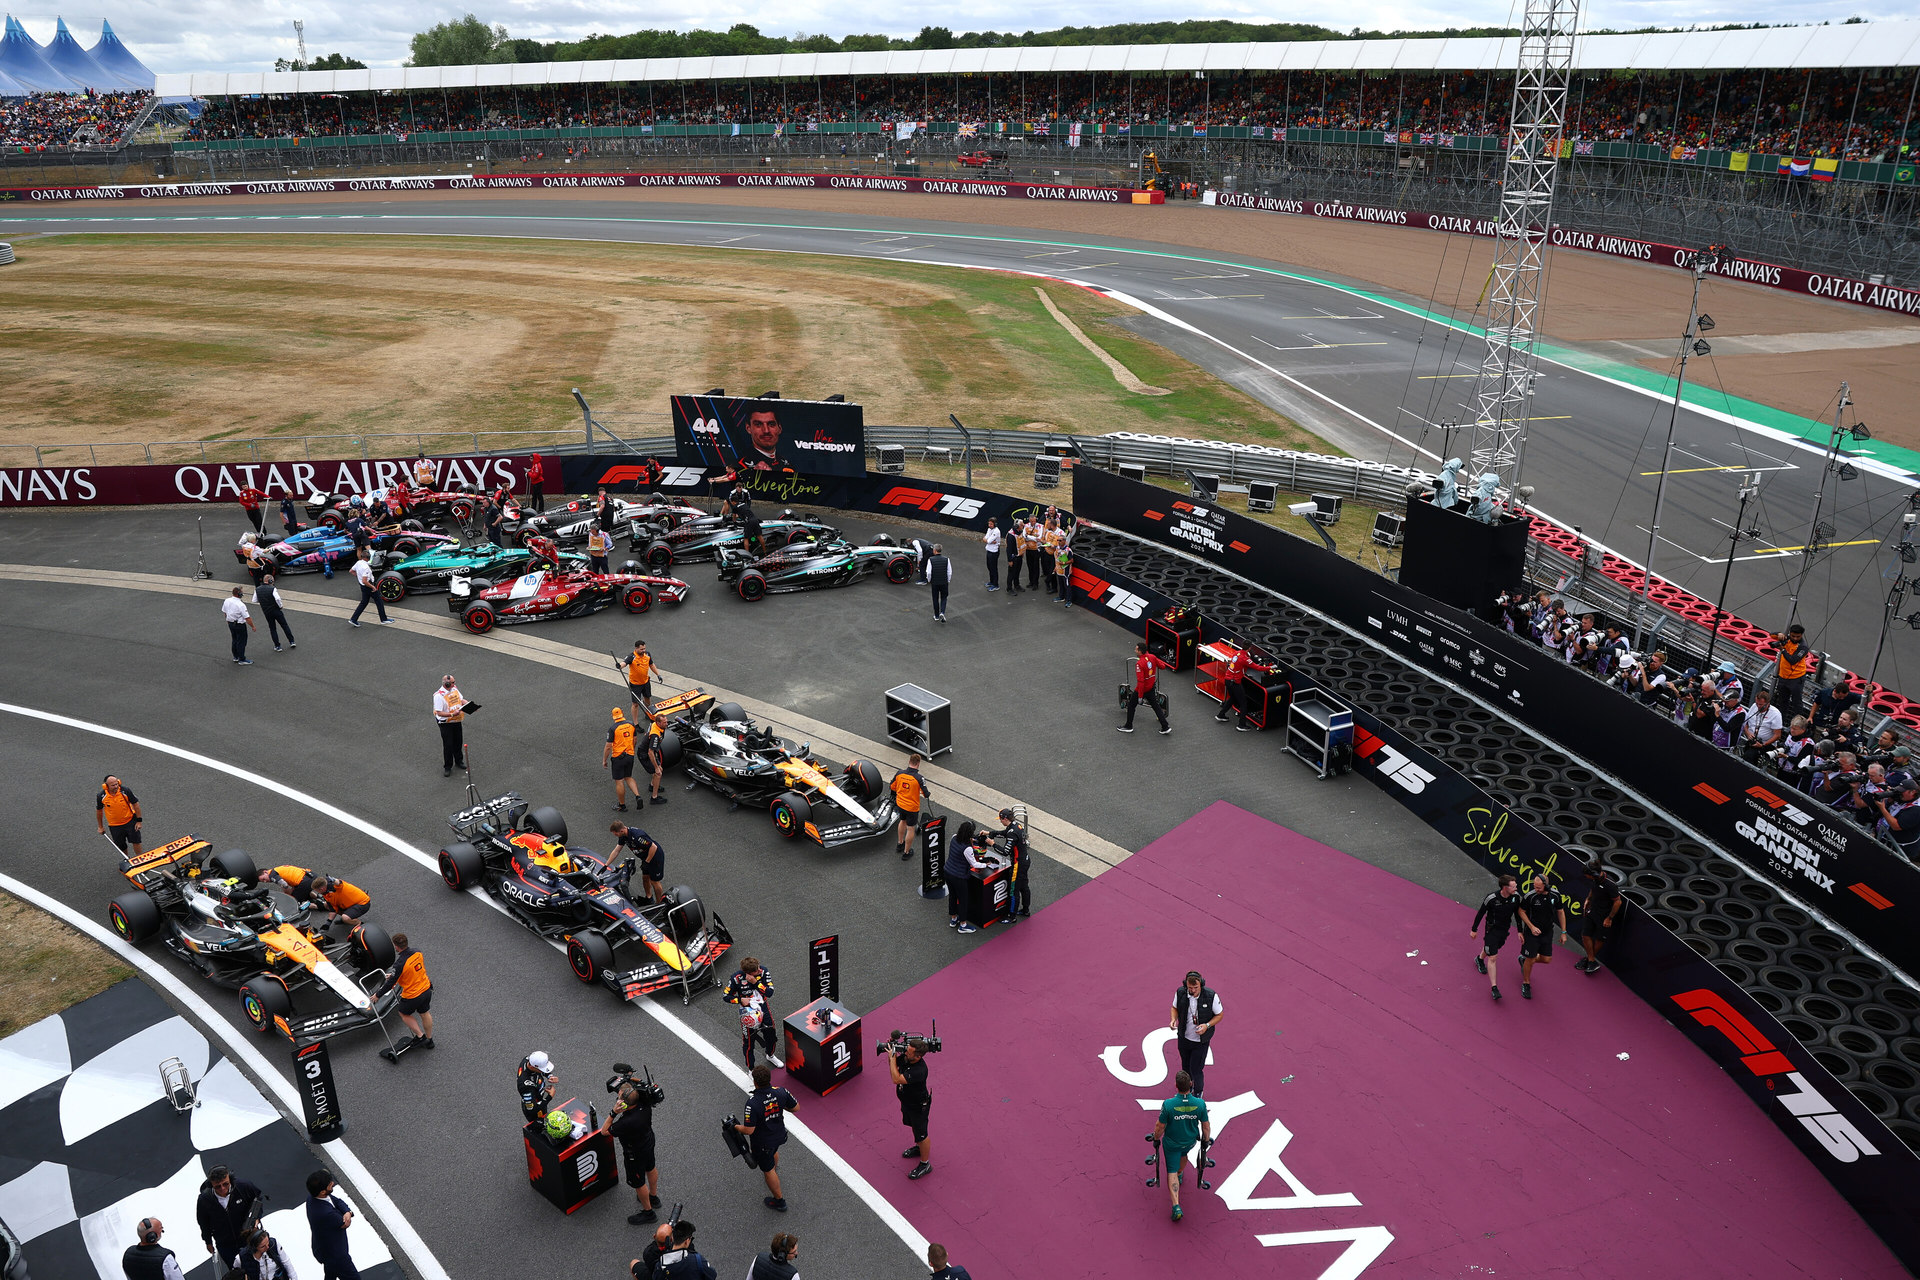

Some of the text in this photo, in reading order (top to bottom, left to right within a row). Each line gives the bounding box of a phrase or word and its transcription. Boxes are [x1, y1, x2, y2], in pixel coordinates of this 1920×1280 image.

[141, 184, 231, 198] QATAR AIRWAYS
[247, 181, 335, 194] QATAR AIRWAYS
[350, 179, 435, 191] QATAR AIRWAYS
[450, 177, 532, 189] QATAR AIRWAYS
[543, 176, 625, 188] QATAR AIRWAYS
[640, 175, 721, 187] QATAR AIRWAYS
[737, 175, 815, 187] QATAR AIRWAYS
[830, 176, 907, 191] QATAR AIRWAYS
[923, 181, 1007, 197] QATAR AIRWAYS
[31, 188, 124, 200] QATAR AIRWAYS
[1026, 186, 1118, 202] QATAR AIRWAYS
[1220, 193, 1303, 214] QATAR AIRWAYS
[1314, 202, 1407, 225] QATAR AIRWAYS
[1428, 214, 1471, 233] QATAR
[1552, 229, 1652, 260] QATAR AIRWAYS
[1720, 259, 1782, 285] AIRWAYS
[1807, 274, 1864, 302] QATAR
[692, 417, 720, 435] 44
[174, 457, 517, 501] QATAR AIRWAYS
[939, 493, 985, 519] 75
[1192, 505, 1210, 518] 75
[1169, 526, 1225, 554] GRAND PRIX
[1179, 520, 1216, 540] BRITISH
[1190, 543, 1205, 553] 2025
[437, 566, 470, 578] aramco
[1105, 584, 1149, 619] 75
[1386, 609, 1409, 627] LVMH
[1439, 636, 1461, 651] aramco
[1376, 744, 1437, 795] 75
[1781, 803, 1815, 826] 75
[1745, 798, 1776, 821] FORMULA
[1786, 824, 1808, 842] QATAR
[1808, 838, 1838, 860] AIRWAYS
[1817, 823, 1848, 847] QATAR
[491, 837, 513, 854] HONDA
[928, 832, 939, 848] 2
[1754, 816, 1821, 868] BRITISH
[1734, 820, 1836, 895] GRAND PRIX
[1768, 859, 1794, 879] 2025
[502, 880, 548, 908] ORACLE
[993, 879, 1008, 904] 2
[817, 950, 831, 965] 1
[627, 964, 659, 981] VISA
[625, 974, 671, 1000] Red
[832, 1041, 851, 1069] 1
[305, 1060, 321, 1079] 3
[311, 1081, 330, 1115] MOËT
[1776, 1071, 1882, 1163] 75
[576, 1150, 599, 1183] 3
